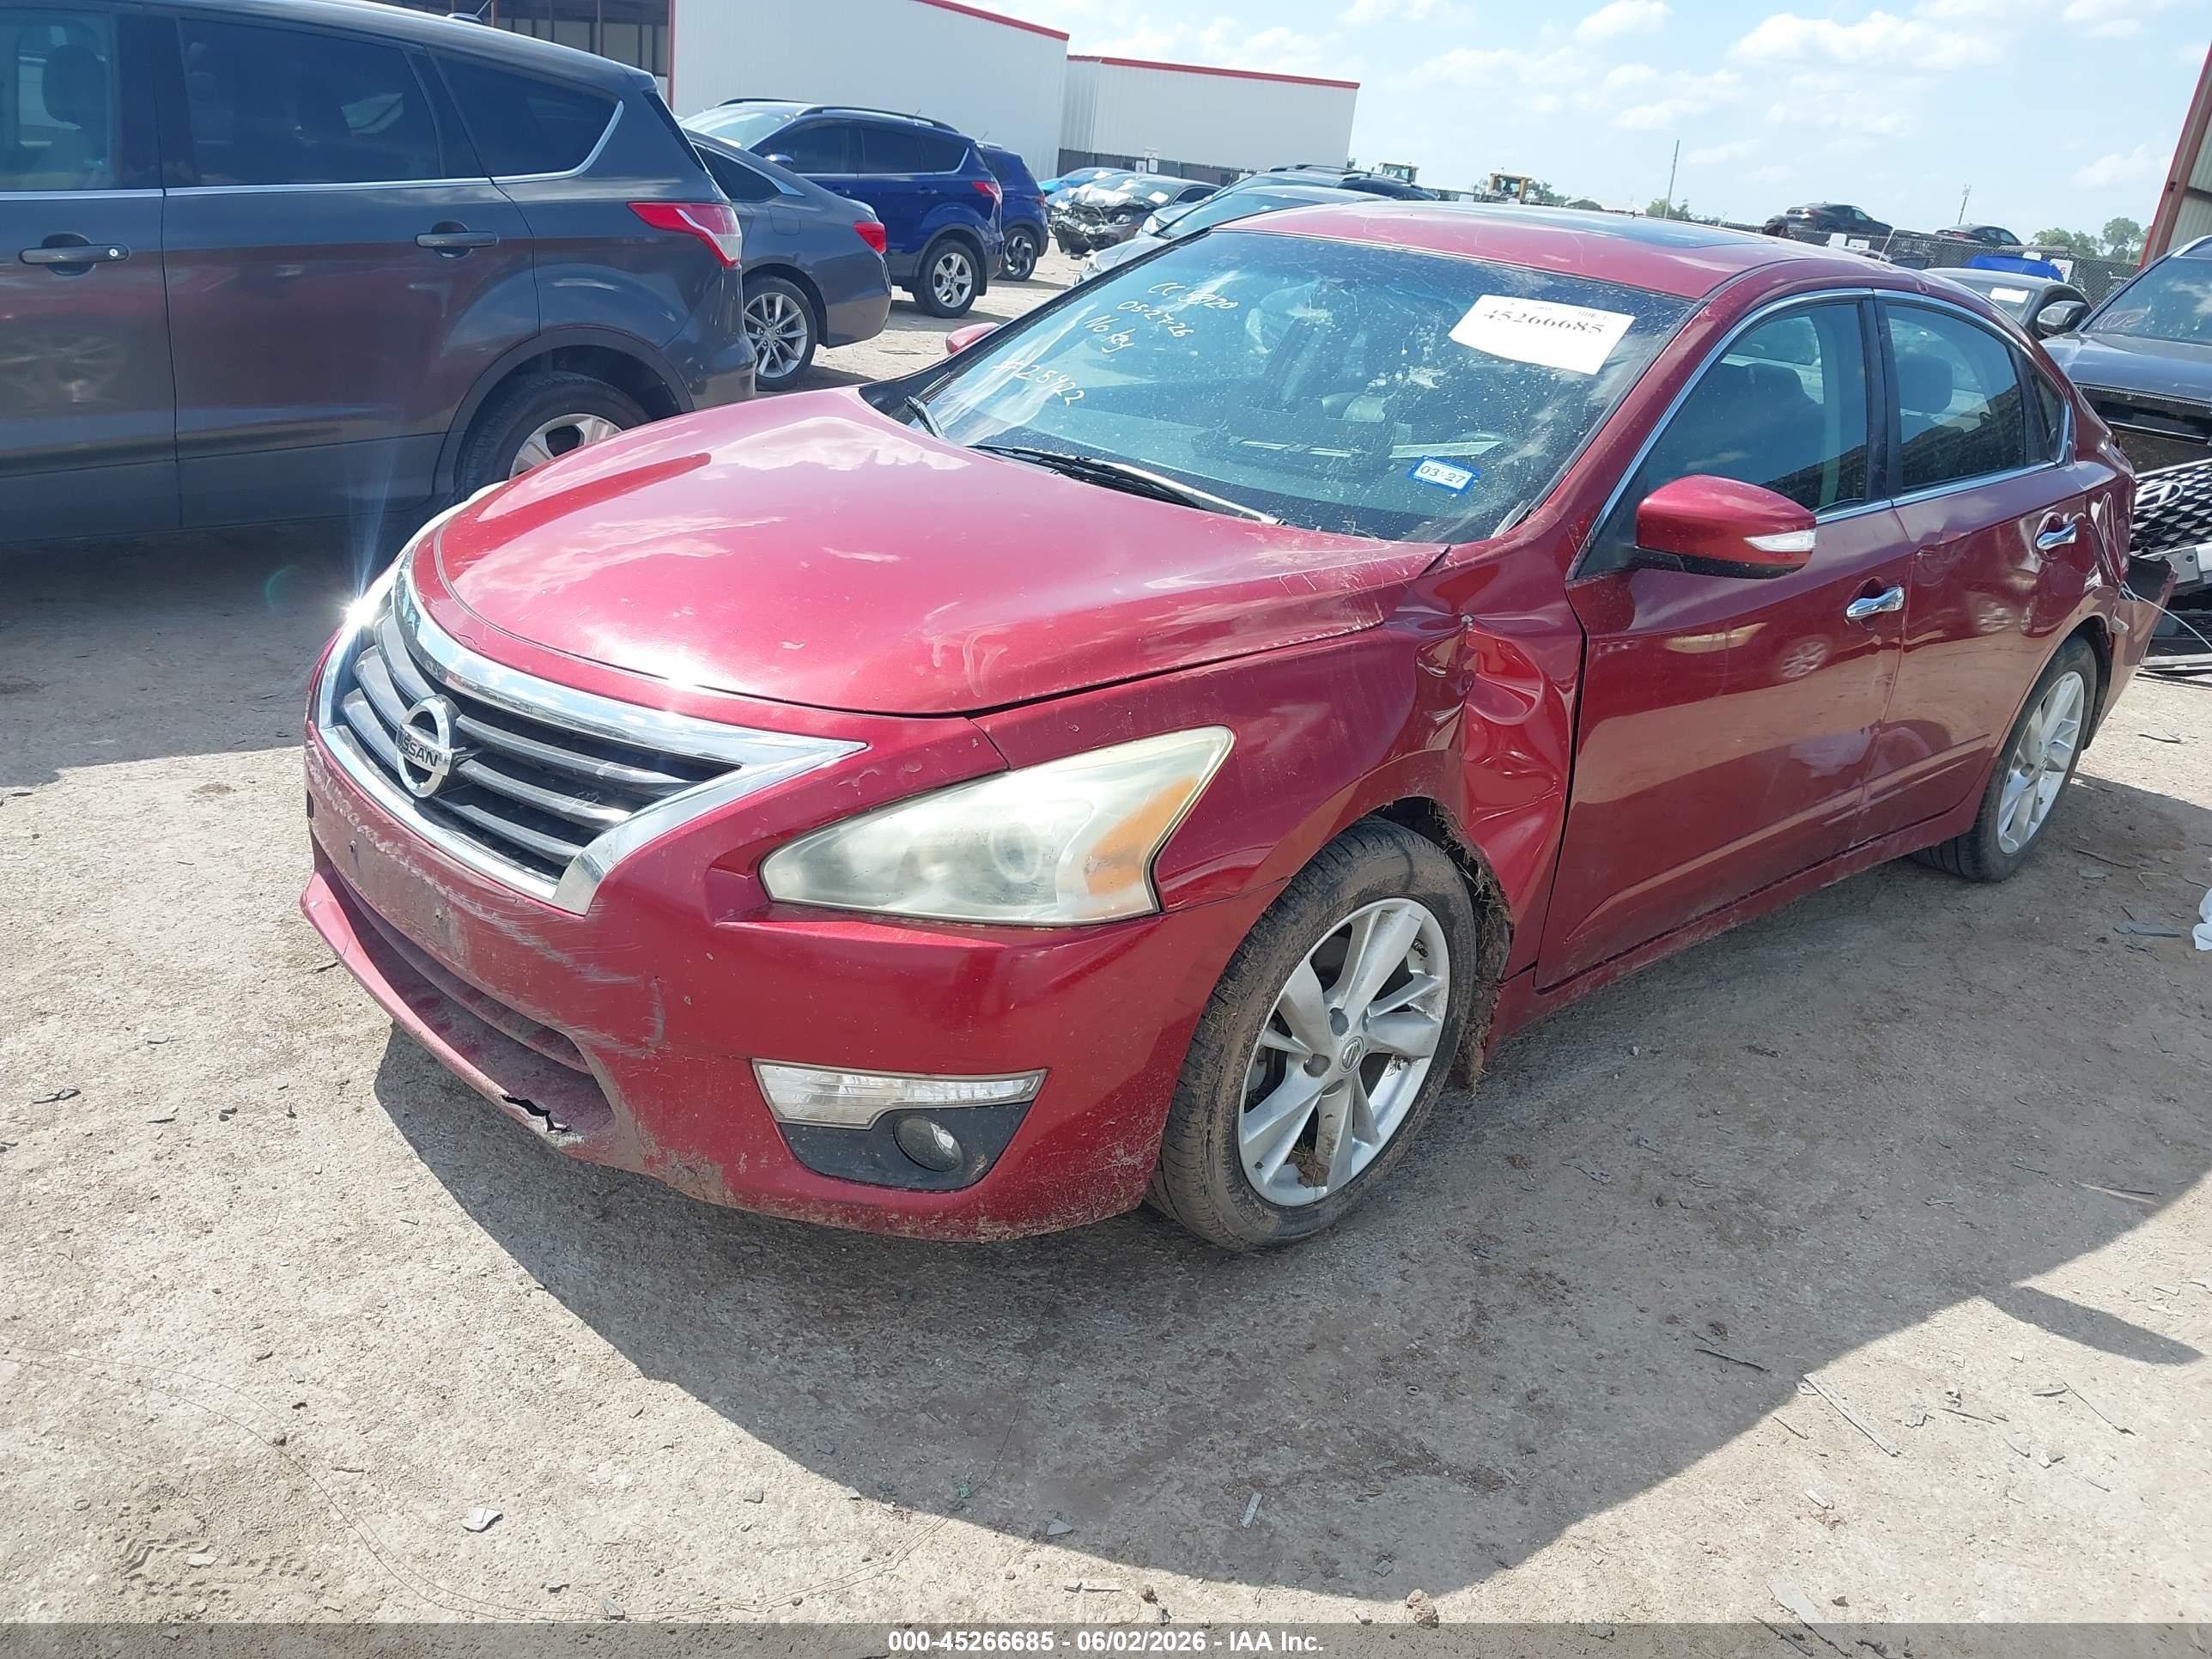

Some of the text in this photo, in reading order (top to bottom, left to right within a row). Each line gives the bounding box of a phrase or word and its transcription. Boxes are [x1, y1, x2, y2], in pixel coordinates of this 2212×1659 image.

[1083, 314, 1121, 333] No
[1483, 309, 1606, 334] 45266685
[398, 732, 439, 767] ISSAN
